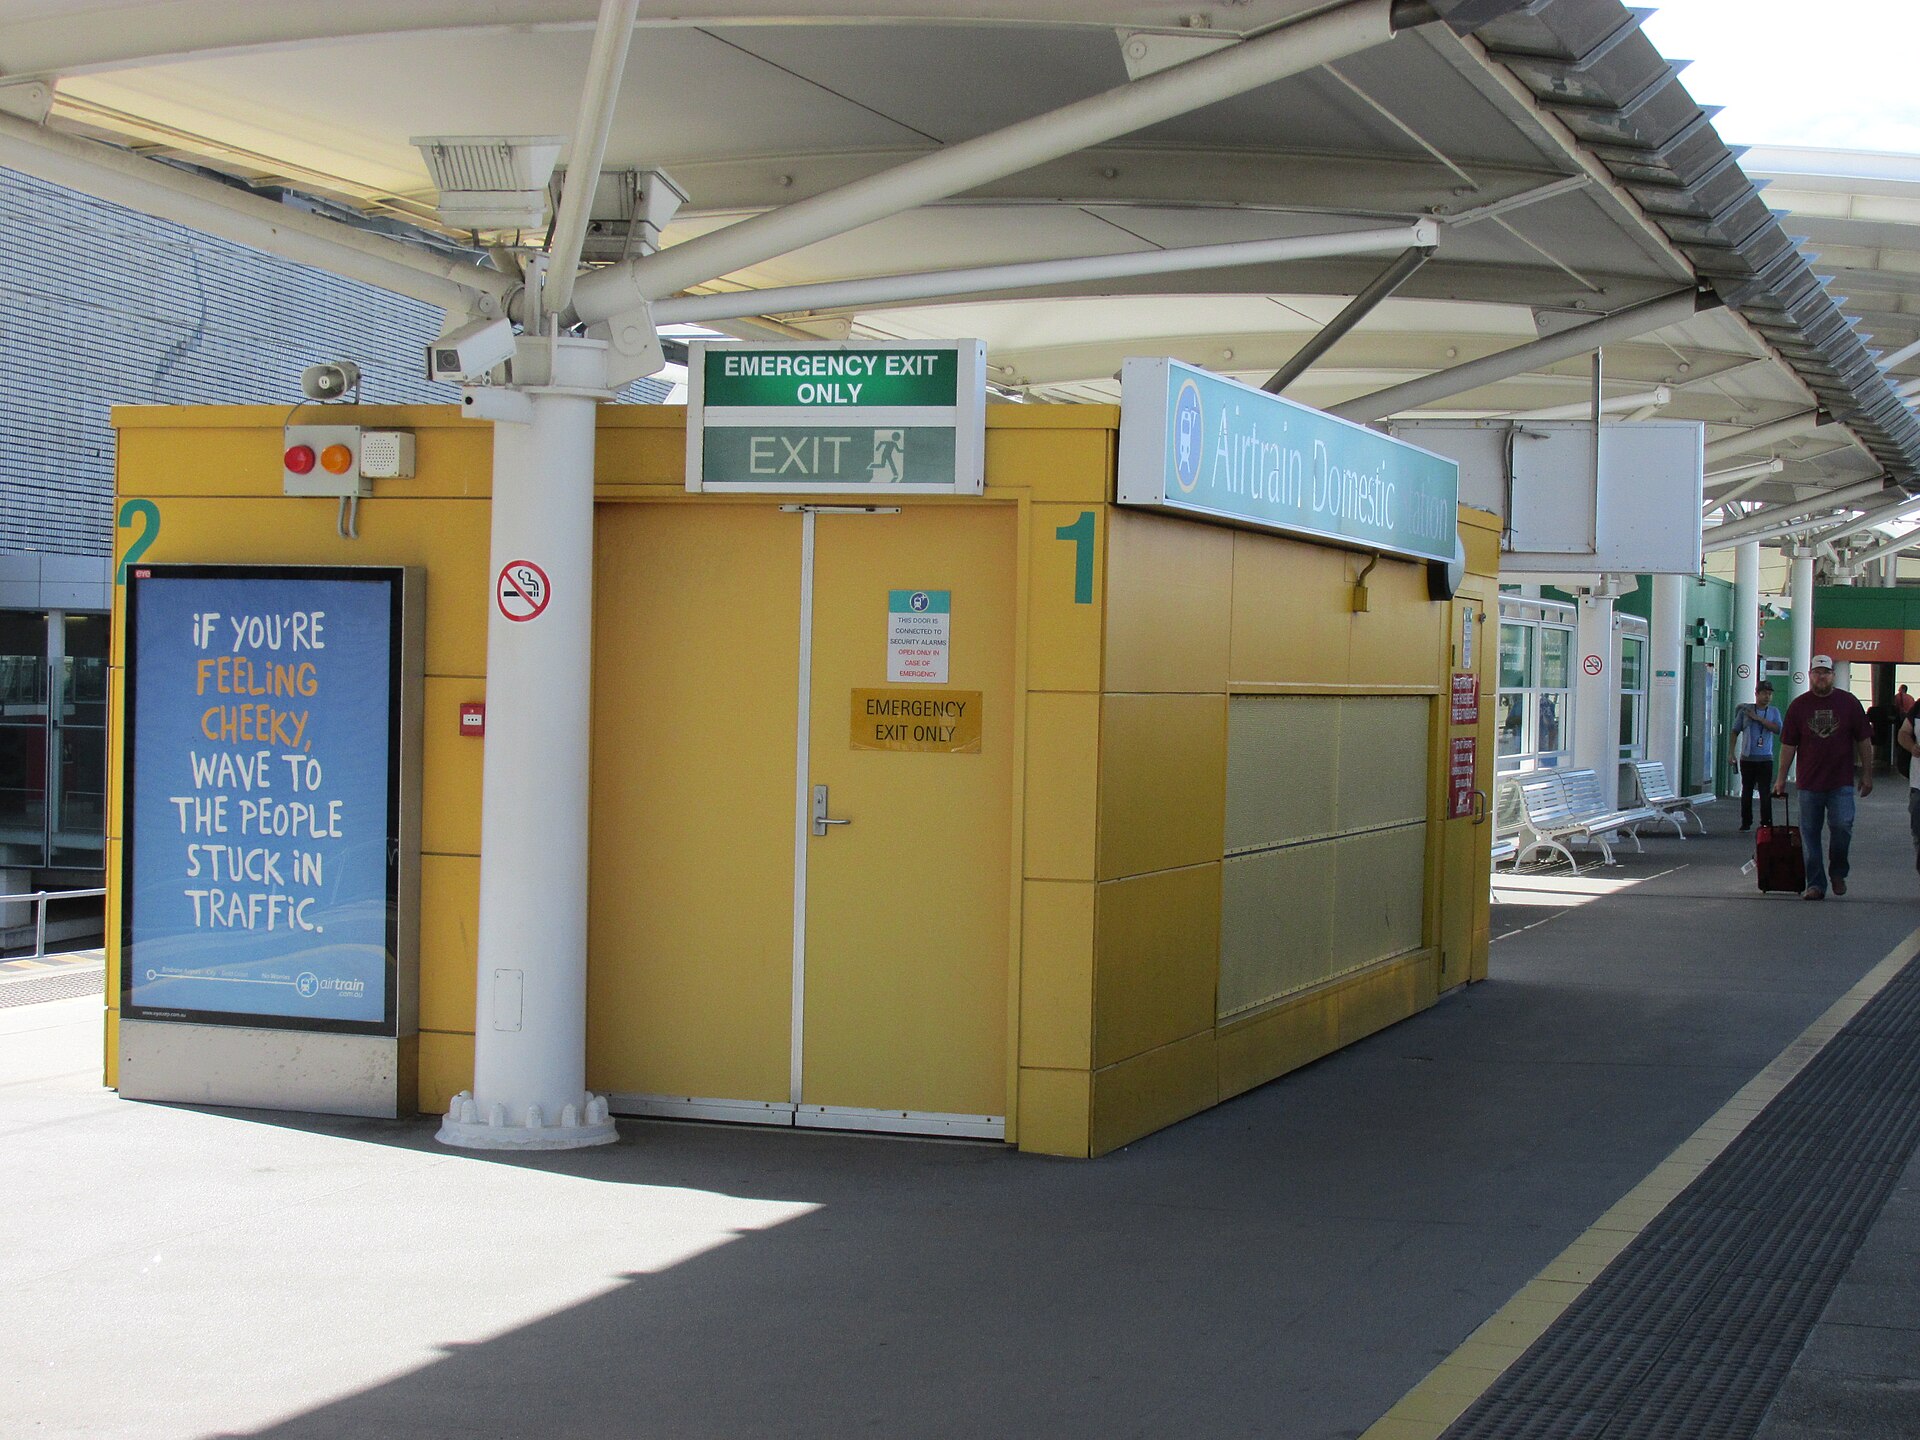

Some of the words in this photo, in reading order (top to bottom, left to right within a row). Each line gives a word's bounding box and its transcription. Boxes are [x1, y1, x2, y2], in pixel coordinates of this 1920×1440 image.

[724, 356, 878, 376] EMERGENCY
[885, 355, 938, 376] EXIT
[797, 383, 863, 404] ONLY
[750, 436, 851, 474] EXIT
[1211, 402, 1301, 509] Airtrain
[1313, 439, 1395, 530] Domestic
[117, 498, 161, 586] 2
[1056, 511, 1096, 605] 1
[231, 611, 326, 652] YOU'RE
[1836, 640, 1853, 650] NO
[1855, 640, 1881, 650] EXIT
[899, 670, 937, 678] EMERGENCY
[201, 703, 312, 752] CHEEKY,
[866, 699, 967, 718] EMERGENCY
[875, 724, 908, 741] EXIT
[913, 725, 956, 742] ONLY
[190, 750, 271, 792] WAVE
[282, 754, 322, 792] TO
[169, 795, 229, 836] THE
[239, 797, 343, 839] PEOPLE
[186, 843, 285, 886] STUCK
[320, 977, 364, 991] airtrain
